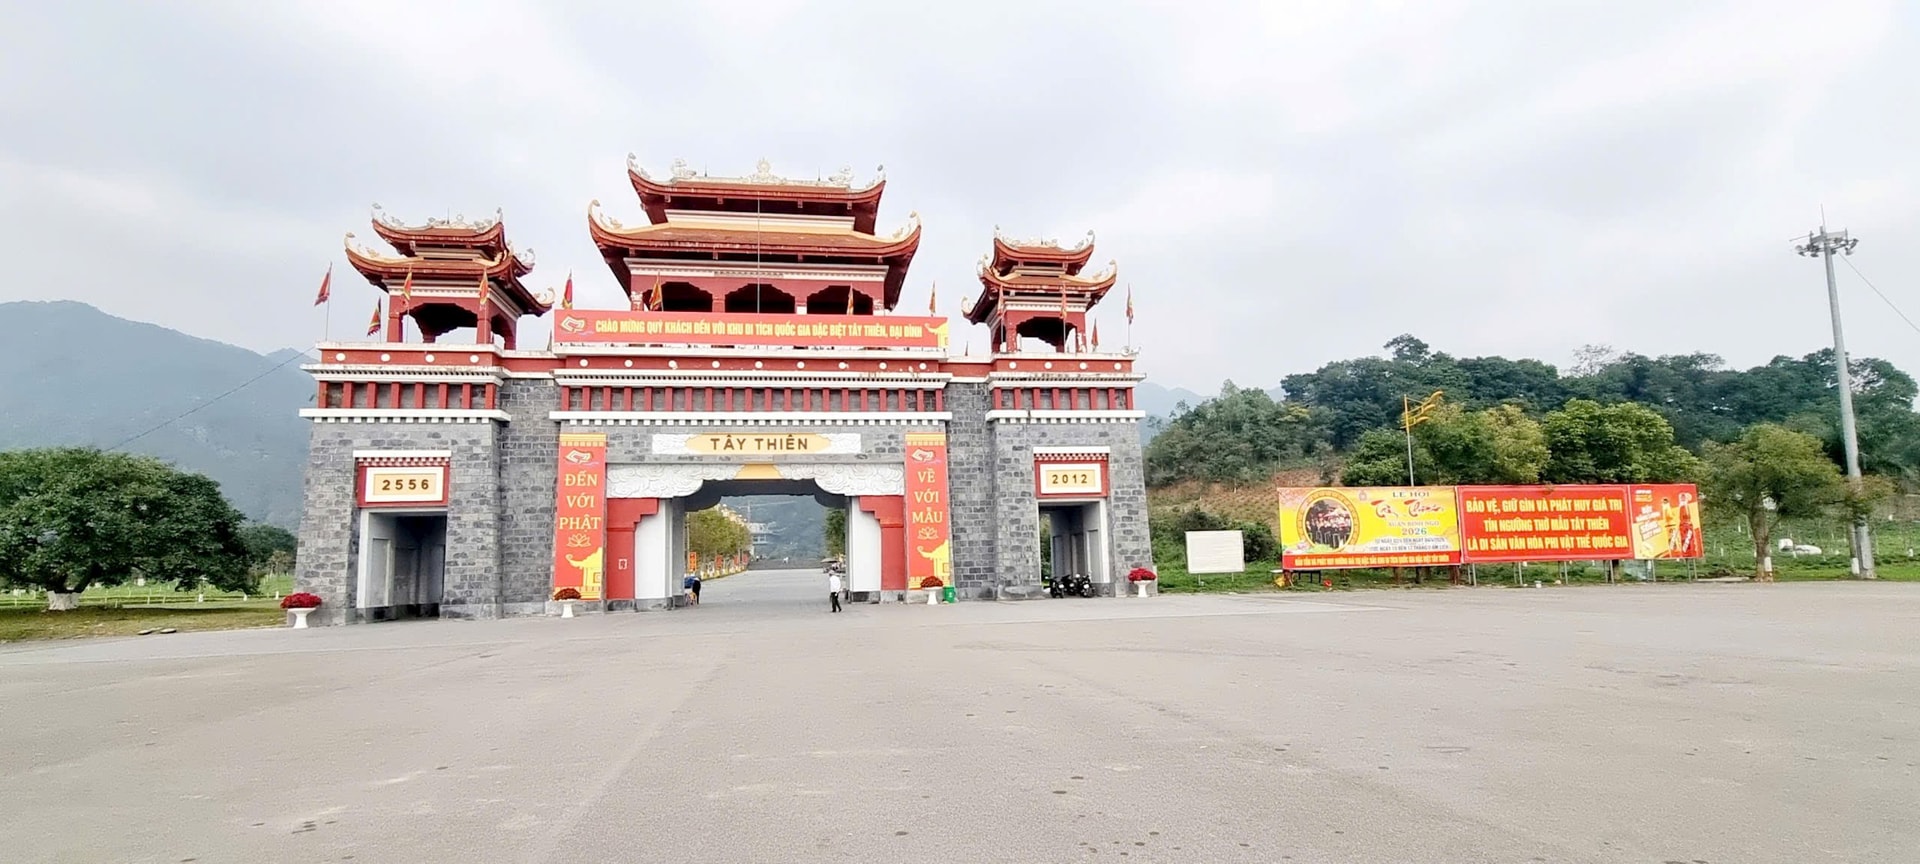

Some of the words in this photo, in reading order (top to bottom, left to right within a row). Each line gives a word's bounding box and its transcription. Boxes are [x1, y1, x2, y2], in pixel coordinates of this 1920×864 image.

[596, 318, 618, 332] CHÀO
[620, 318, 645, 333] MỪNG
[665, 320, 692, 334] KHÁCH
[694, 320, 711, 334] ĐẾN
[712, 320, 726, 335] VỚI
[727, 322, 744, 335] KHU
[745, 323, 754, 335] DI
[755, 322, 773, 336] TÍCH
[774, 320, 796, 337] QUỐC
[798, 324, 811, 336] GIA
[812, 322, 828, 339] ĐẶC
[830, 322, 846, 339] BIỆT
[848, 322, 862, 337] TÂY
[864, 322, 888, 338] THIÊN,
[890, 325, 902, 340] ĐẠI
[904, 324, 922, 338] ĐÌNH
[710, 434, 746, 450] TÂY
[754, 434, 808, 450] THIÊN
[565, 470, 598, 487] ĐẾN
[918, 468, 935, 483] VỀ
[1052, 474, 1087, 484] 2012
[382, 479, 429, 491] 2556
[566, 492, 595, 508] VỚI
[914, 488, 939, 503] VỚI
[1466, 496, 1485, 512] BẢO
[1486, 498, 1500, 515] VỆ,
[1502, 498, 1518, 512] GIỮ
[1519, 498, 1535, 512] GÌN
[1536, 498, 1549, 512] VÀ
[1550, 497, 1572, 512] PHÁT
[1574, 499, 1591, 512] HUY
[1592, 497, 1608, 512] GIÁ
[1608, 499, 1623, 513] TRỊ
[912, 506, 943, 523] MẪU
[559, 514, 602, 533] PHẬT
[1483, 518, 1498, 532] TÍN
[1499, 517, 1533, 532] NGƯỠNG
[1534, 516, 1550, 531] THỜ
[1551, 515, 1569, 531] MẪU
[1570, 516, 1585, 530] TÂY
[1586, 516, 1610, 530] THIÊN
[1468, 536, 1479, 551] LÀ
[1479, 538, 1489, 551] DI
[1490, 535, 1508, 551] SẢN
[1508, 536, 1526, 550] VĂN
[1545, 537, 1559, 549] PHI
[1560, 534, 1574, 551] VẬT
[1576, 532, 1592, 549] THẾ
[1592, 533, 1614, 550] QUỐC
[1614, 536, 1629, 548] GIA
